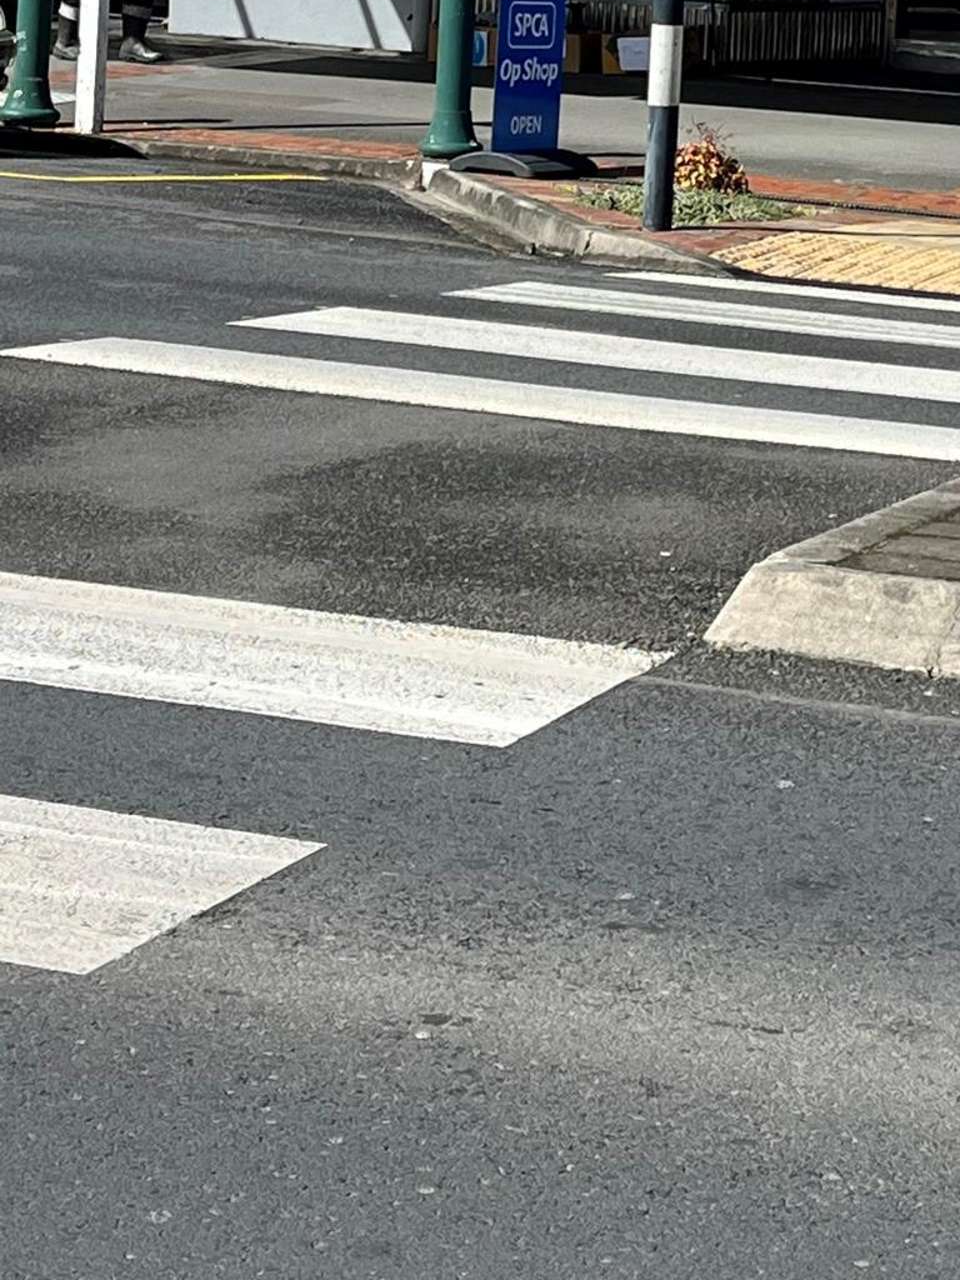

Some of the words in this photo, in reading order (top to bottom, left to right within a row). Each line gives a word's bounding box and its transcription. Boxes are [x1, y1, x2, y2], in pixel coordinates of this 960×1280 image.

[514, 12, 549, 38] SPCA
[500, 58, 521, 87] Op
[522, 56, 558, 87] Shop
[510, 116, 542, 135] OPEN
